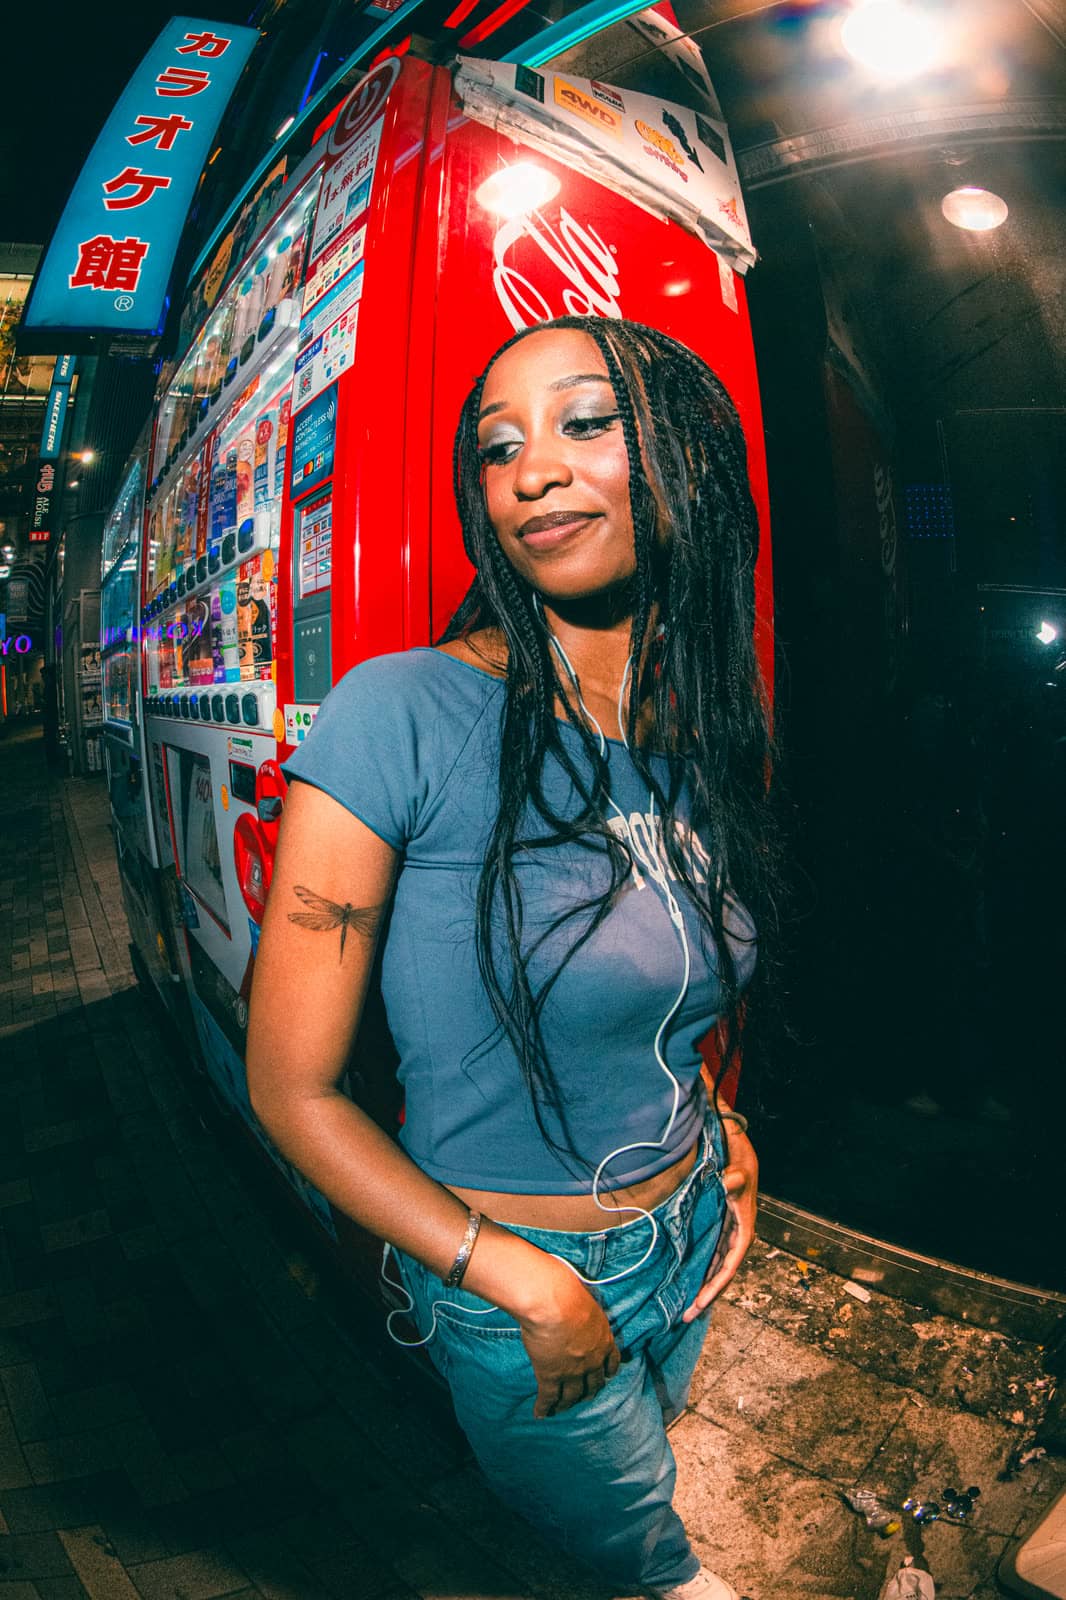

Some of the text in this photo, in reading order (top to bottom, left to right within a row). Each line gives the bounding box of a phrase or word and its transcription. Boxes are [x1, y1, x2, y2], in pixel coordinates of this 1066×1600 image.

[560, 89, 617, 127] 4WD
[69, 31, 232, 293] カラオケ館
[46, 391, 63, 451] SKECHERS
[36, 464, 56, 493] HUB
[33, 496, 44, 528] HOUSE
[41, 496, 50, 514] ALE
